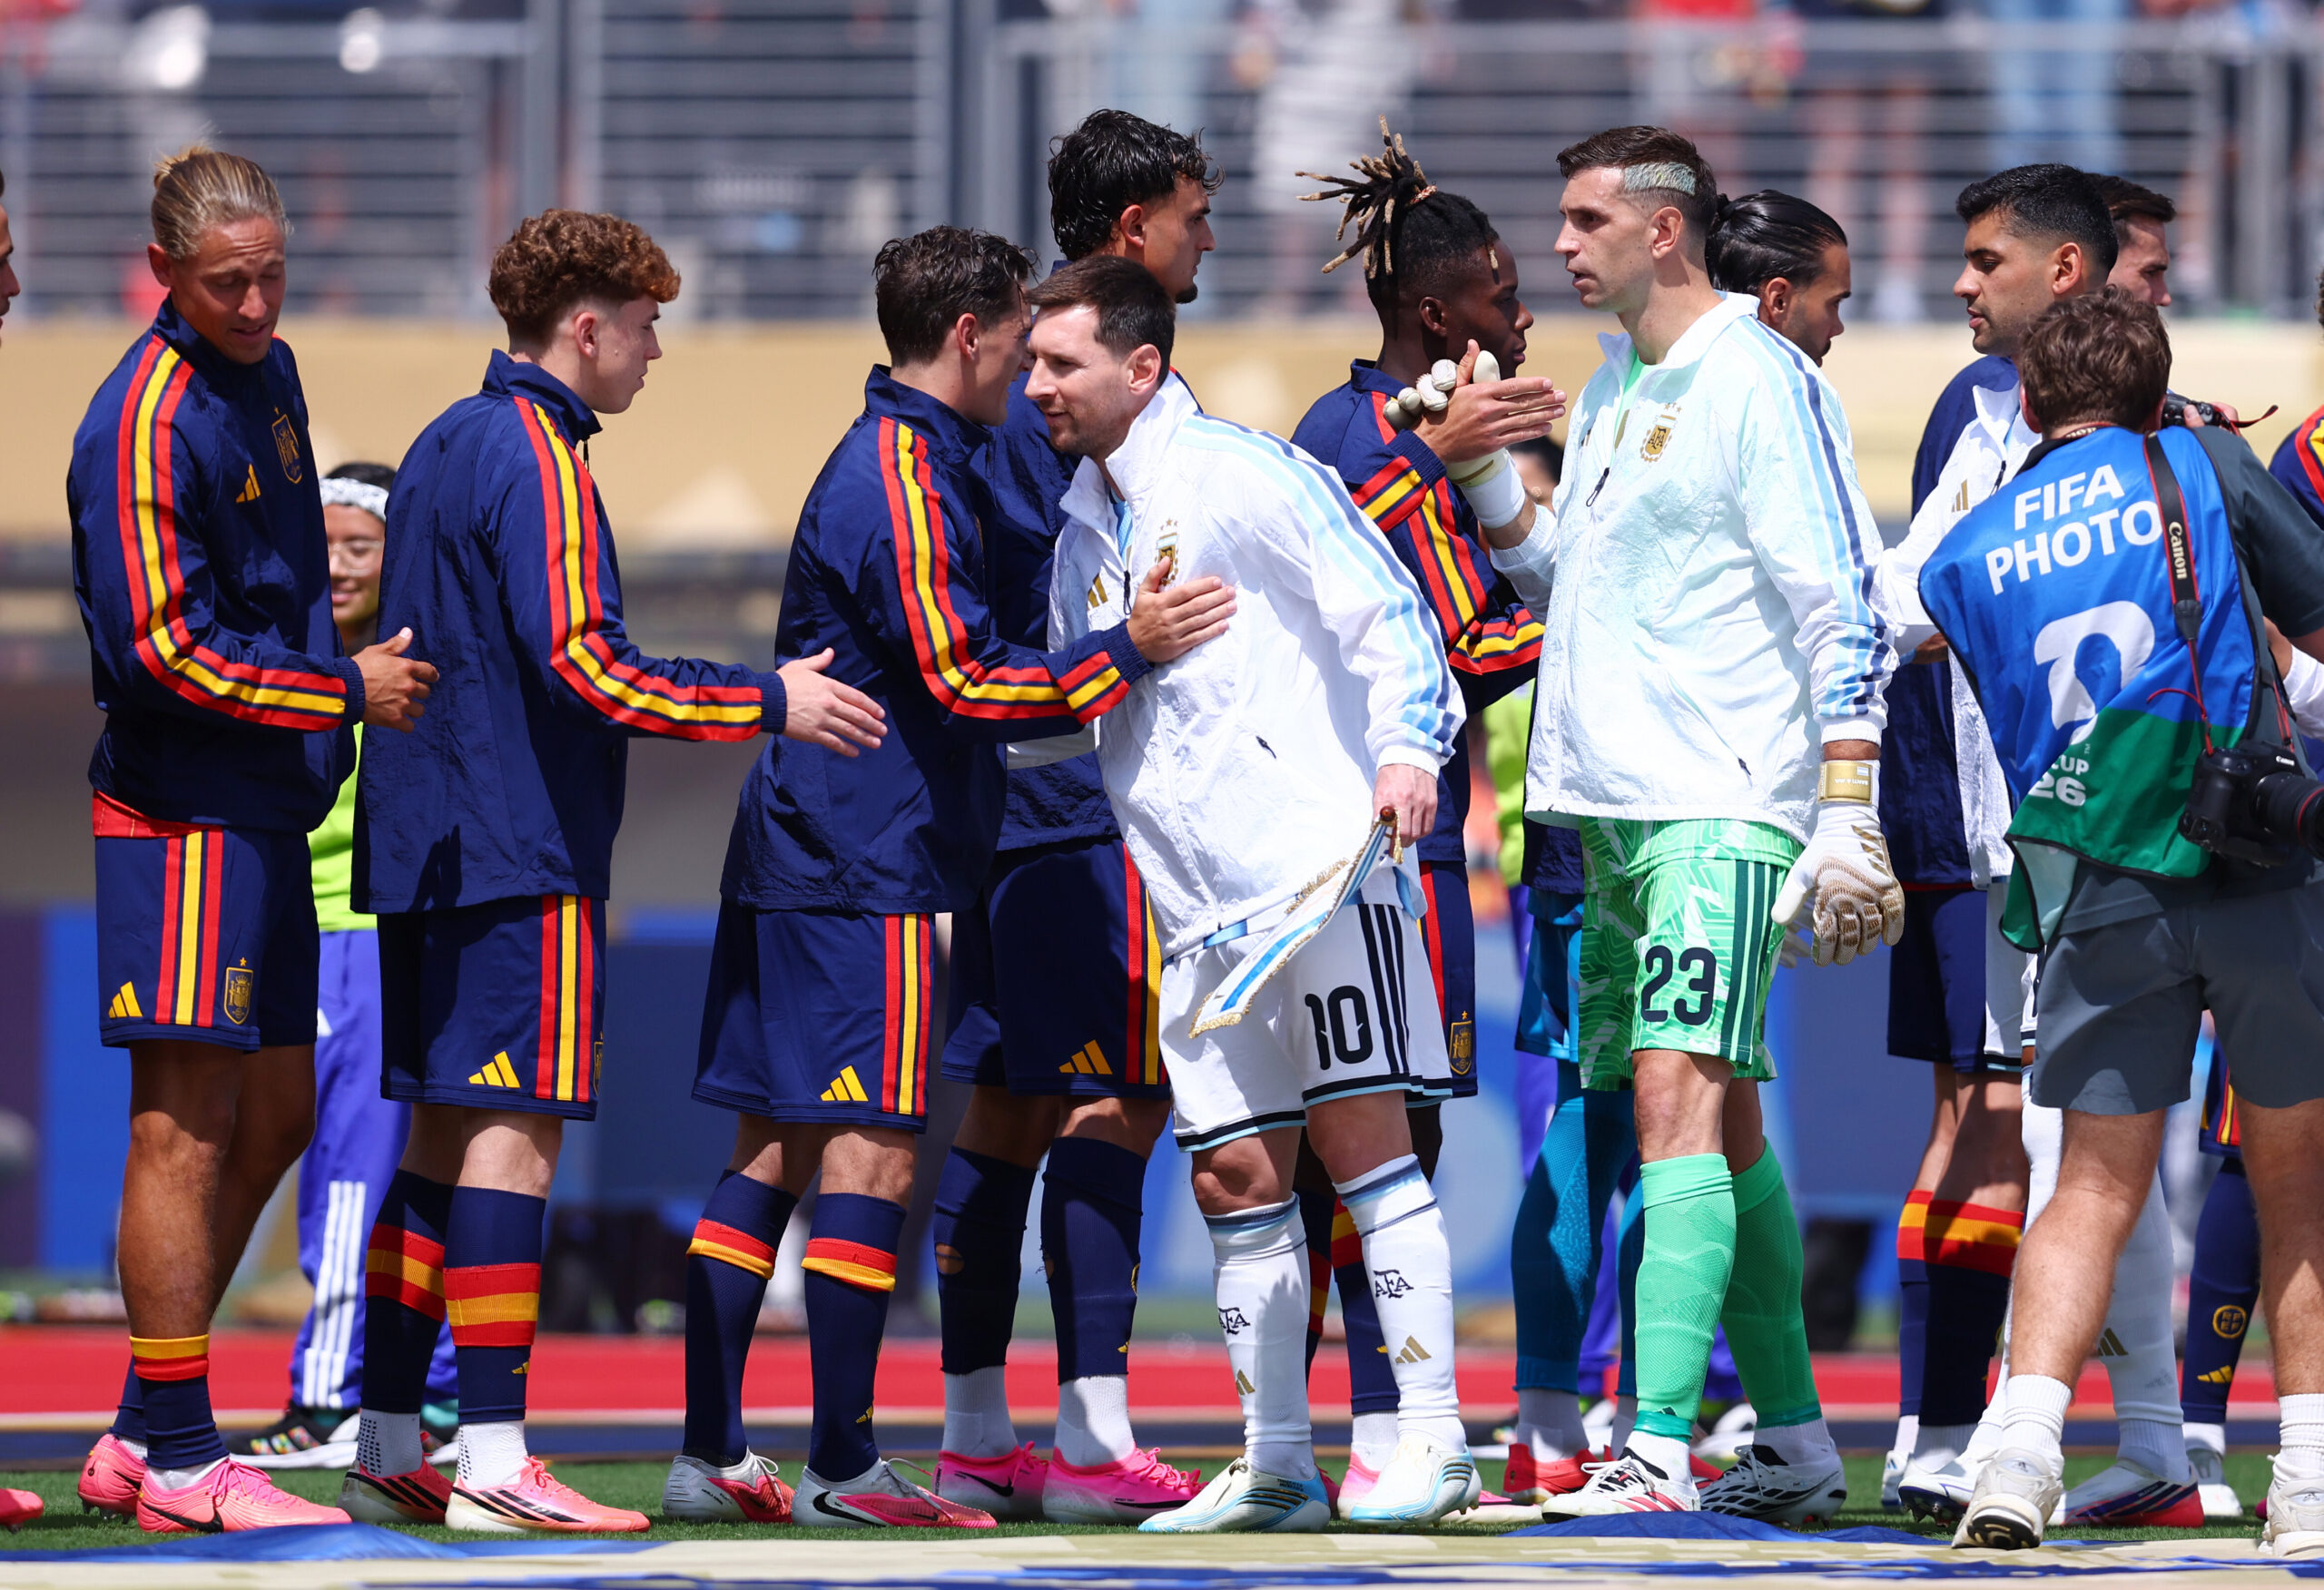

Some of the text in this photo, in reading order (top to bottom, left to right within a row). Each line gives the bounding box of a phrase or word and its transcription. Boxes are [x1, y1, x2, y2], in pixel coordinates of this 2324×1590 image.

[2014, 464, 2125, 531] FIFA
[1985, 500, 2163, 595] PHOTO
[2169, 521, 2188, 579] Canon
[2027, 771, 2086, 807] 26
[1640, 945, 1717, 1026] 23
[1305, 986, 1373, 1070] 10
[1374, 1270, 1413, 1298] AFA
